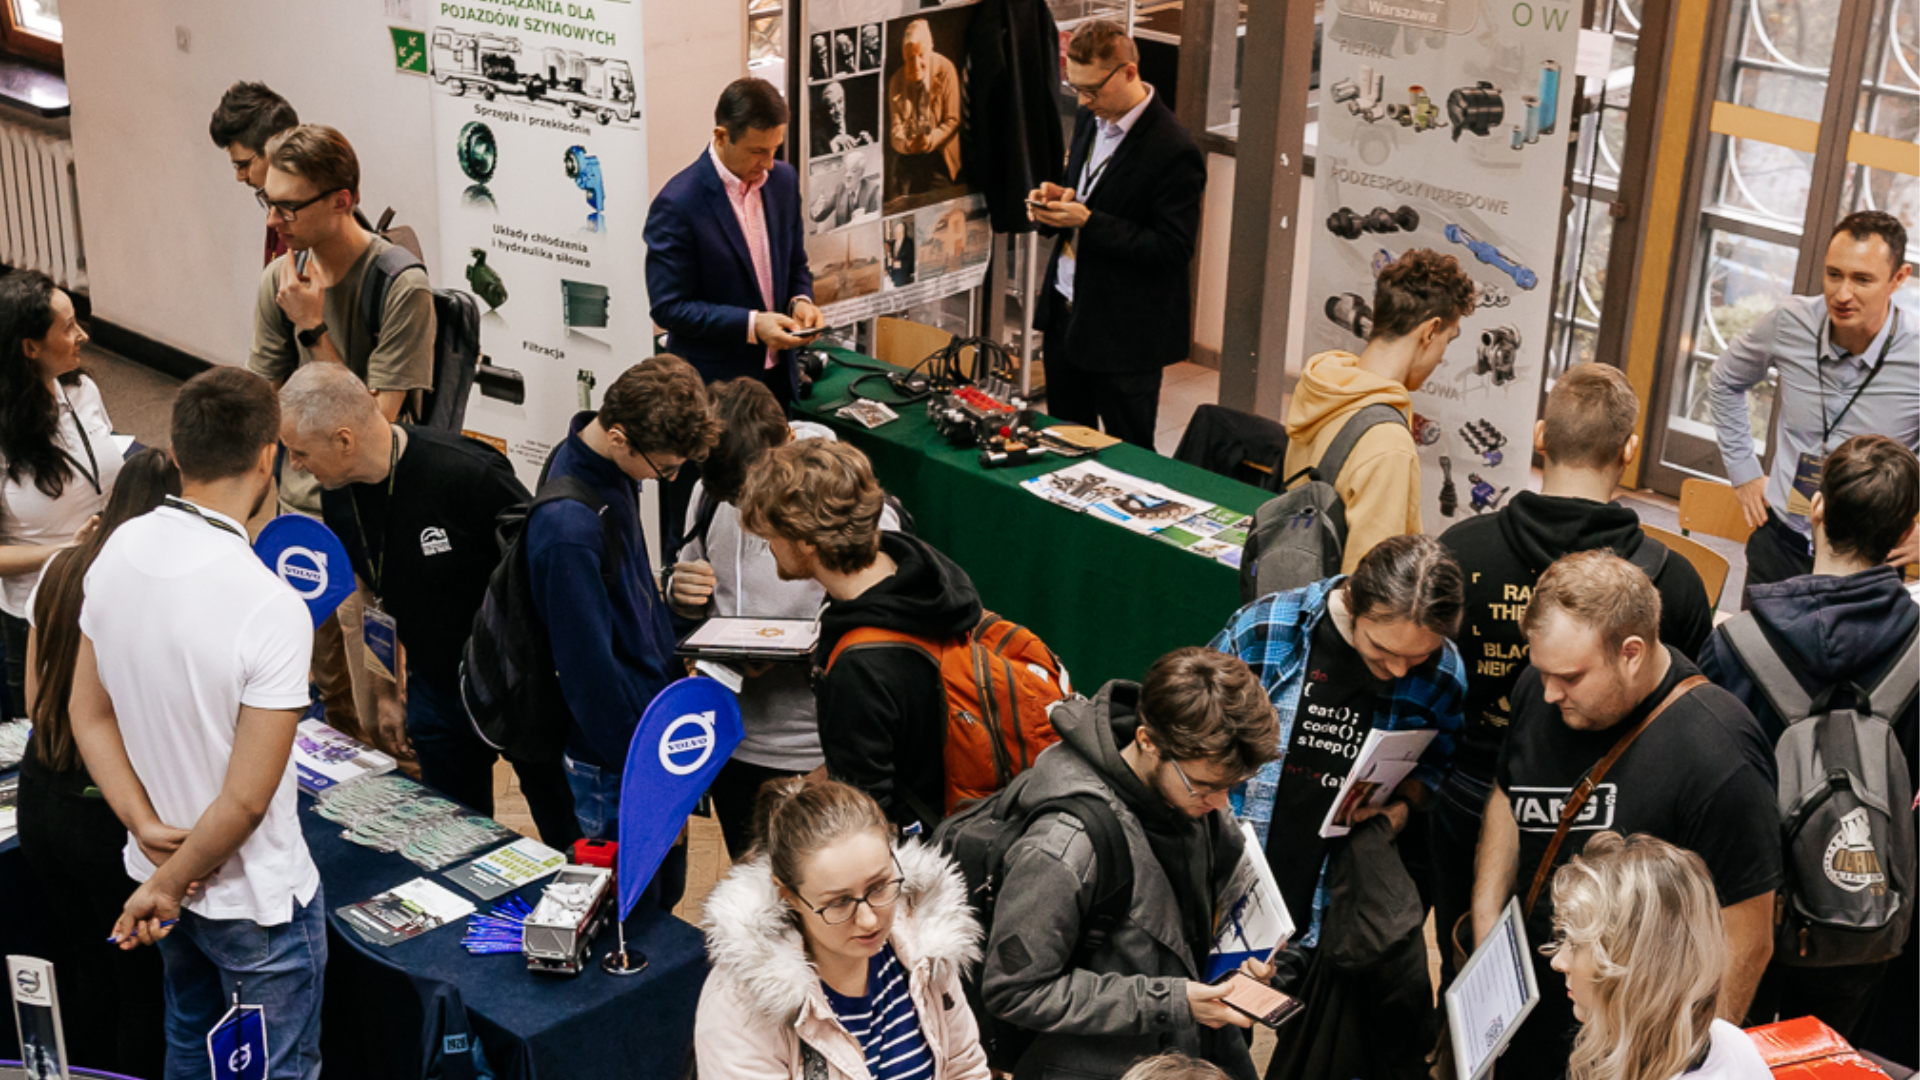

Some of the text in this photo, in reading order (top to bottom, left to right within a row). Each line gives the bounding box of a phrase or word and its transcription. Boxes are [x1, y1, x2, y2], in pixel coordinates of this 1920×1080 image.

[567, 3, 595, 21] DLA
[1368, 0, 1438, 23] Warszawa
[441, 3, 519, 28] POJAZDÓW
[523, 16, 616, 46] SZYNOWYCH
[473, 103, 519, 123] Sprzęgła
[522, 111, 527, 123] i
[1424, 185, 1510, 215] NAPĘDOWE
[493, 224, 588, 253] Układy chłodzenia
[498, 239, 553, 260] hydraulika
[556, 253, 592, 268] siłowa
[523, 340, 565, 360] Filtracja
[285, 566, 321, 580] VOLVO
[1504, 584, 1536, 601] RA
[1310, 669, 1328, 682] do
[1308, 703, 1360, 725] eat();
[1302, 720, 1364, 744] code();
[668, 737, 707, 751] VOLVO
